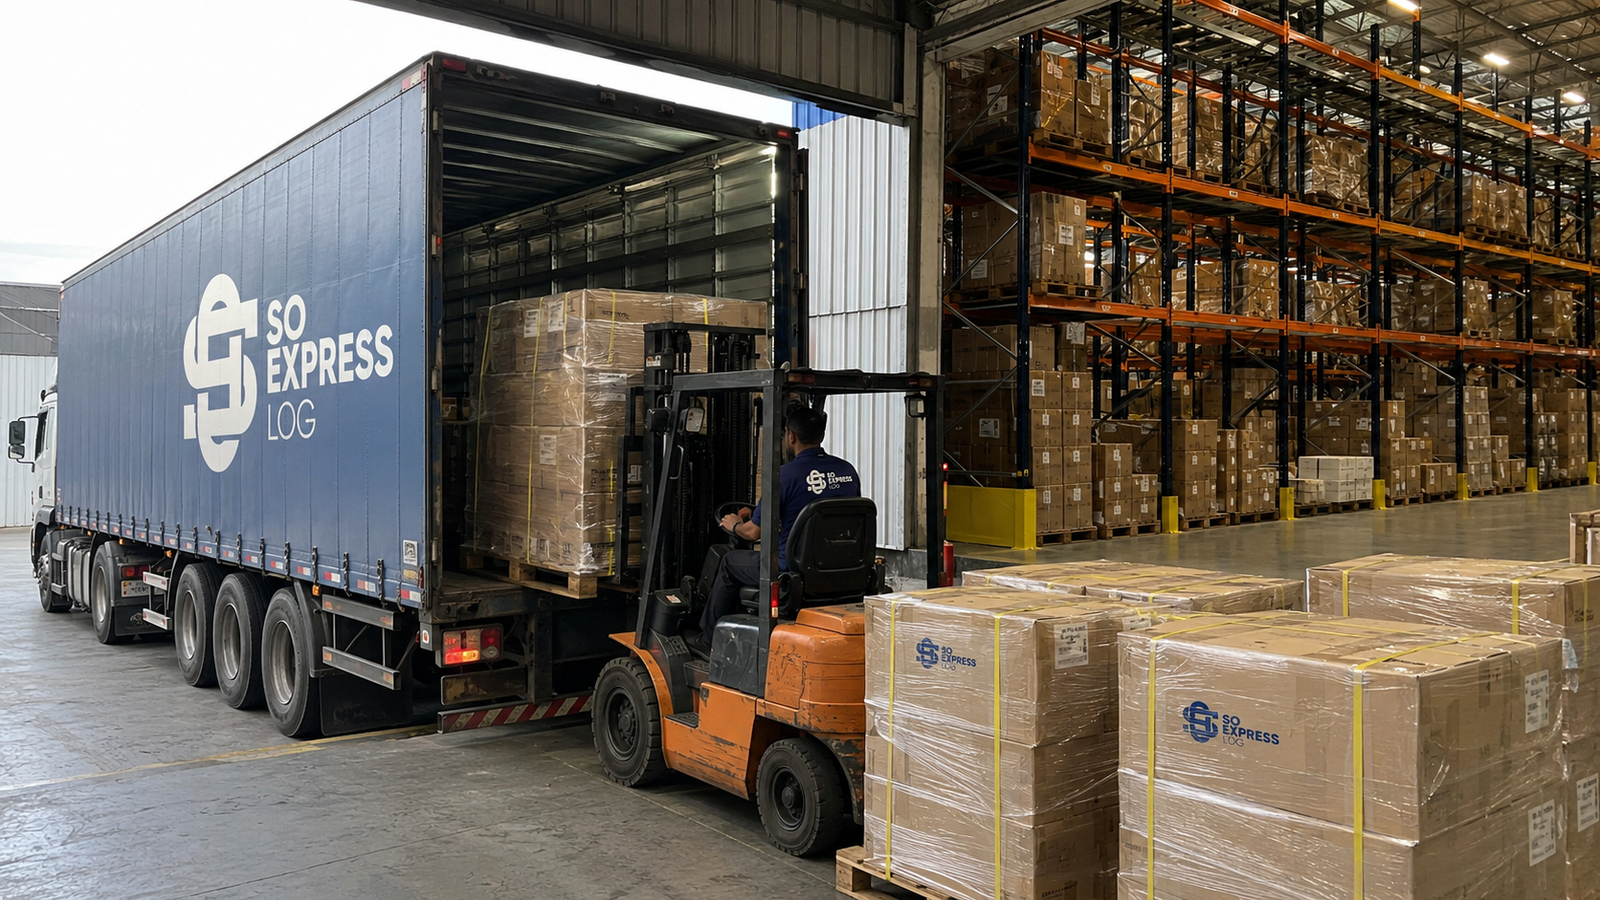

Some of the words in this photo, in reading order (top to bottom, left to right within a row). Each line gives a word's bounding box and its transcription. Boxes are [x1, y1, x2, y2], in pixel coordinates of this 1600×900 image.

[266, 294, 306, 345] SO
[267, 324, 394, 394] EXPRESS
[267, 398, 316, 441] LOG
[941, 646, 953, 655] SO
[941, 653, 977, 668] EXPRESS
[1222, 714, 1241, 726] SO
[1222, 725, 1280, 745] EXPRESS
[1222, 736, 1245, 748] LOG
